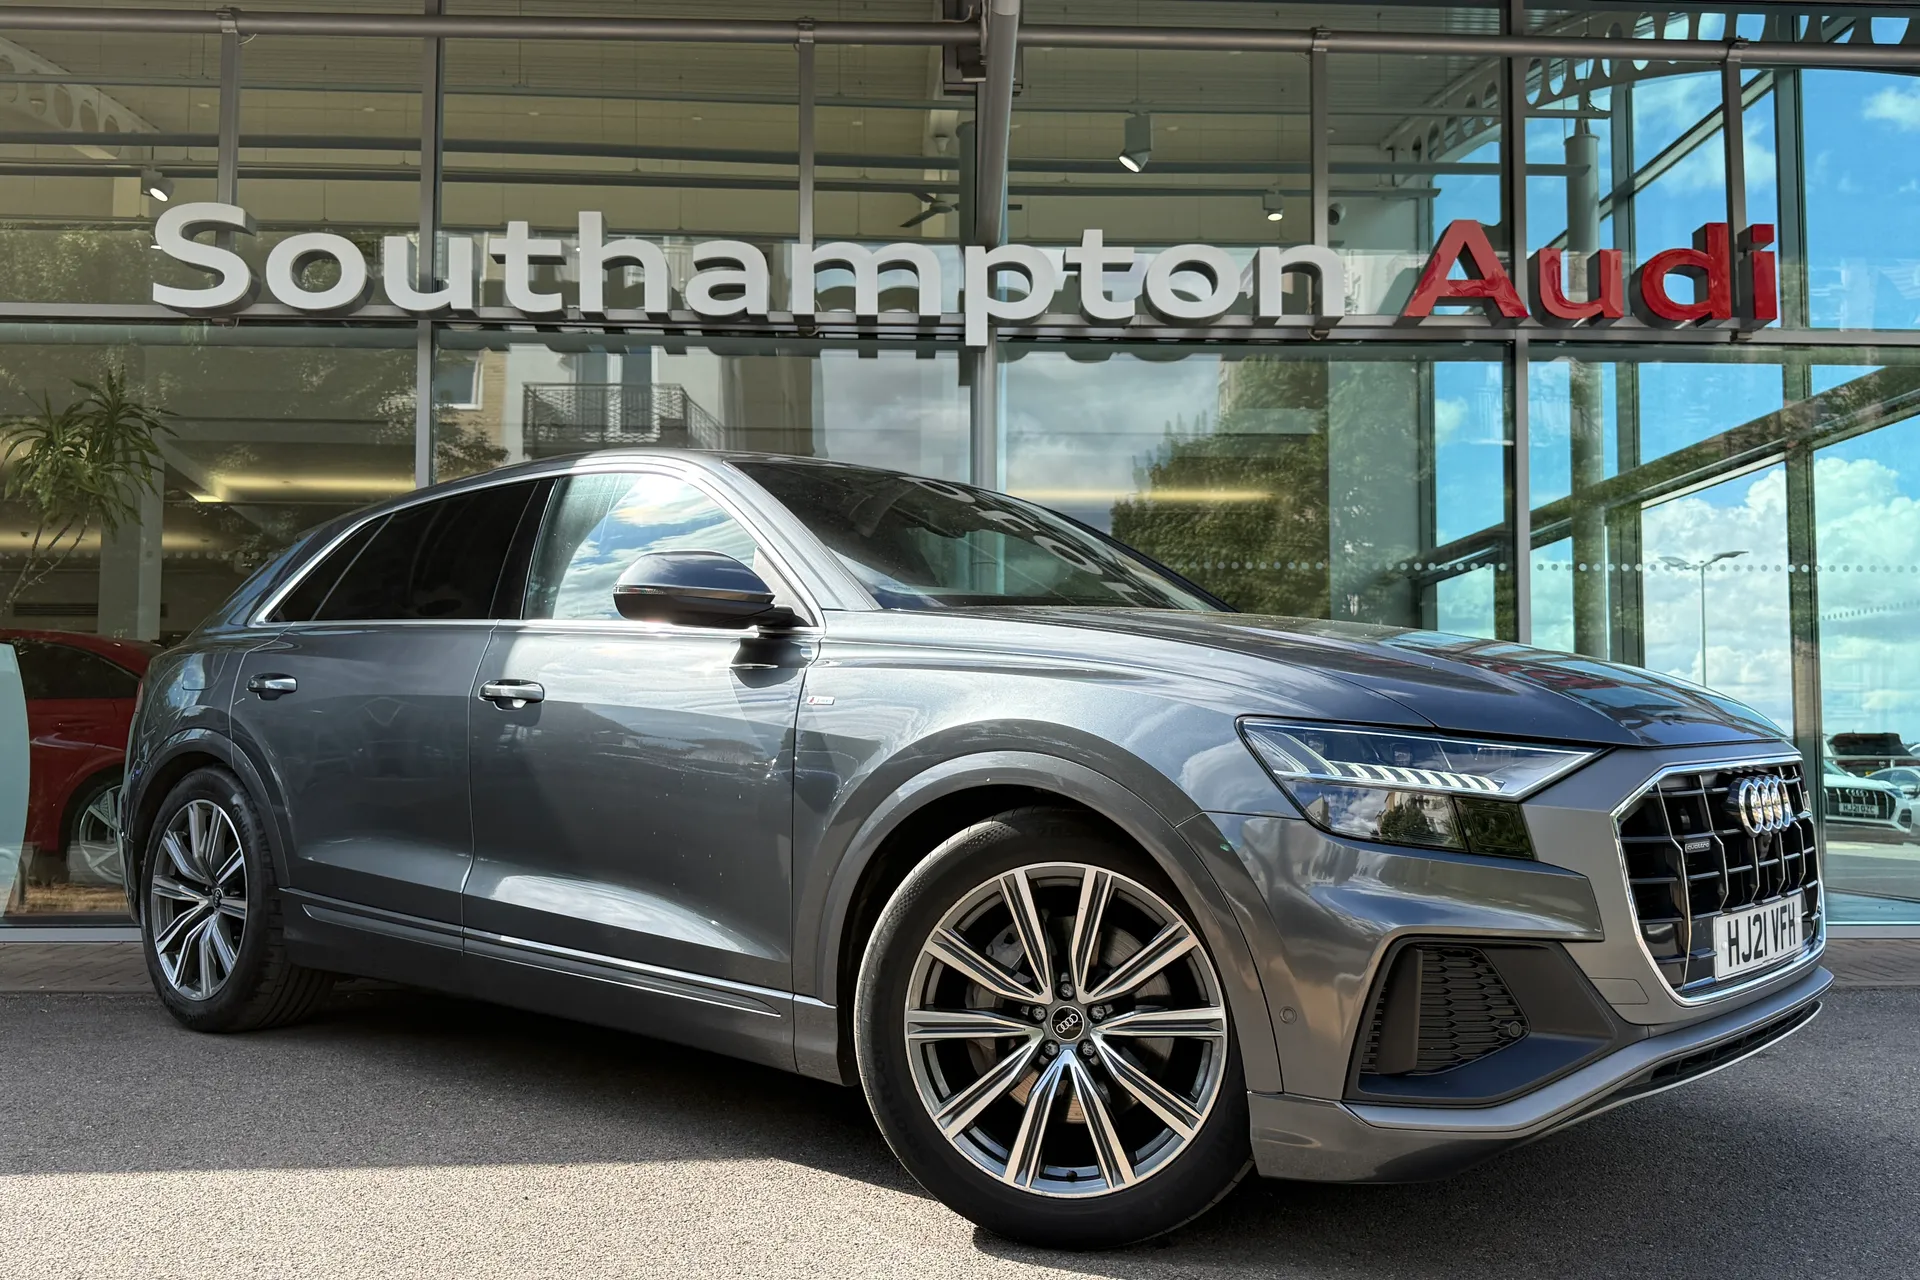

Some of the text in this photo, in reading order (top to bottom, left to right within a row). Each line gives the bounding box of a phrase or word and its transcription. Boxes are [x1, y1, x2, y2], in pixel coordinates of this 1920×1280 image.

[152, 202, 1779, 346] Southampton Audi
[1727, 902, 1796, 967] HJ21 VFH
